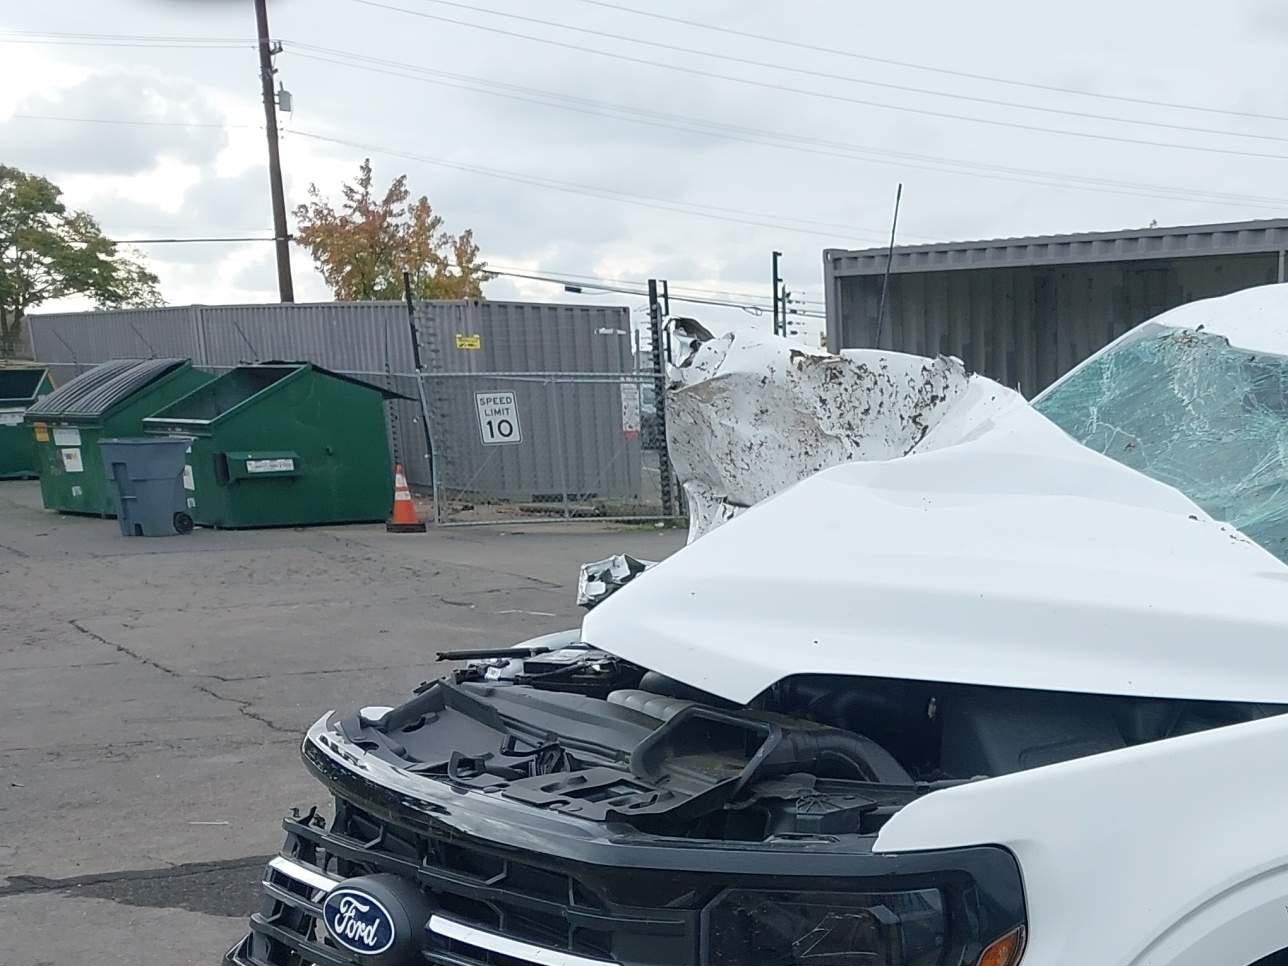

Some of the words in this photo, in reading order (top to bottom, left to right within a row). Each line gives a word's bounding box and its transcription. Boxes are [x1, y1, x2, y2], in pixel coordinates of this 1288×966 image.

[479, 396, 513, 407] SPEED
[484, 408, 511, 418] LIMIT
[486, 419, 514, 440] 10
[334, 896, 380, 947] Ford
